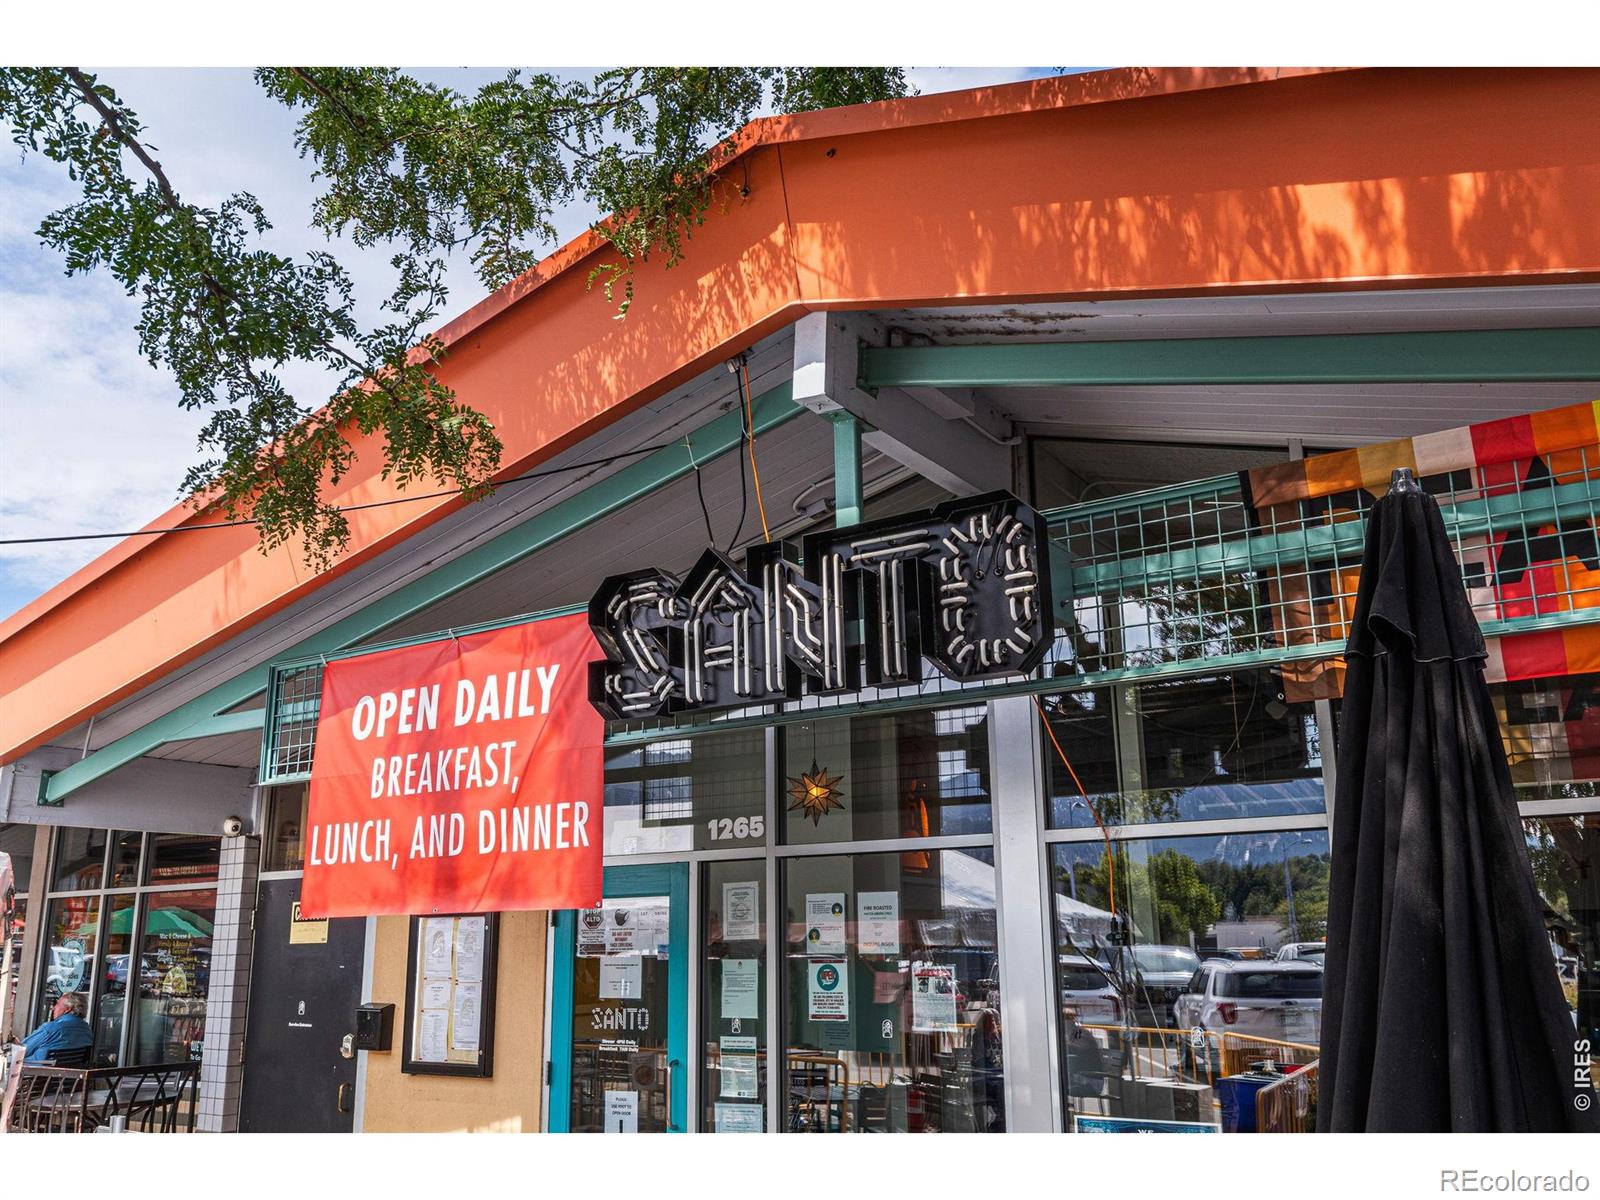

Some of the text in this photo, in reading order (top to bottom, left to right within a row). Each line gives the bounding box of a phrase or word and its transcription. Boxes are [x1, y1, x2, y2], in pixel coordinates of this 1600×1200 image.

[590, 491, 1053, 720] SANTO
[351, 664, 560, 741] OPEN DAILY
[370, 740, 519, 799] BREAKFAST,
[310, 801, 590, 870] LUNCH, AND DINNER
[707, 815, 765, 841] 1265
[591, 1007, 650, 1031] SANTO
